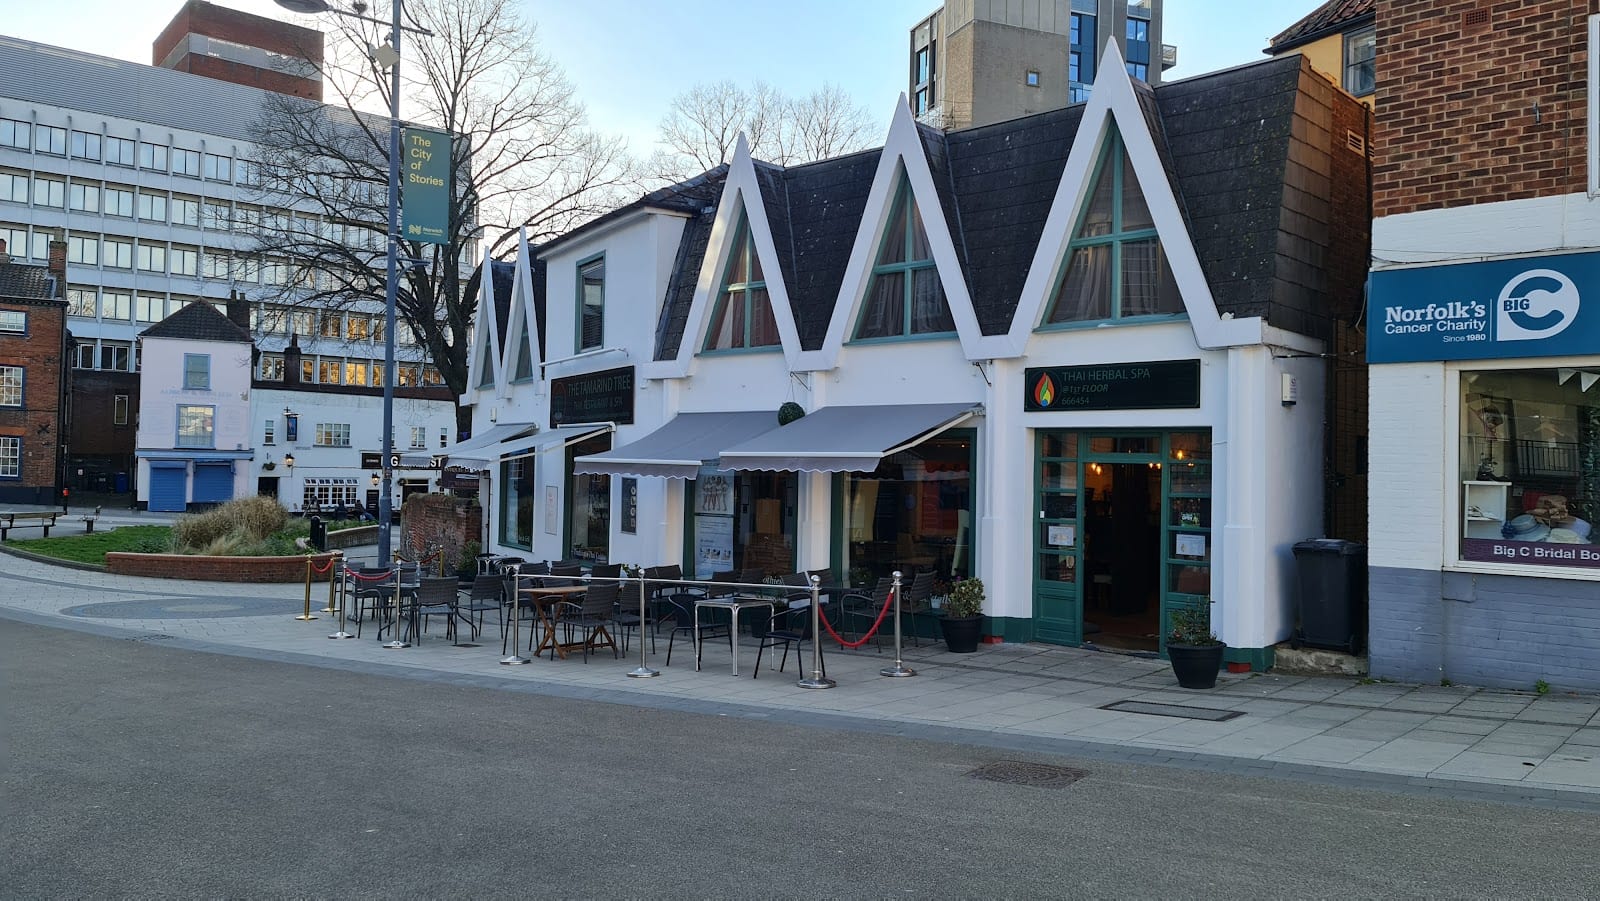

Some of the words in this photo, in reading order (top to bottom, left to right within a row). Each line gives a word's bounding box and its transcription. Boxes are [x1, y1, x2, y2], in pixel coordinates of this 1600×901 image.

[411, 135, 431, 147] The
[410, 148, 432, 161] City
[410, 161, 422, 171] of
[409, 173, 444, 186] Stories
[1384, 300, 1486, 323] Norfolk's
[1503, 298, 1530, 312] BIG
[1384, 322, 1433, 335] Cancer
[1436, 319, 1486, 333] Charity
[1442, 335, 1465, 343] Since
[1466, 334, 1486, 342] 1980
[1061, 371, 1086, 382] THAI
[1088, 369, 1128, 381] HERBAL
[1130, 367, 1151, 380] SPA
[567, 382, 579, 397] THE
[580, 376, 613, 395] TAMARIND
[613, 374, 631, 392] TREE
[1081, 384, 1109, 393] FLOOR
[1061, 396, 1090, 405] 666454
[1493, 545, 1516, 558] Big
[1519, 546, 1530, 557] C
[1534, 547, 1576, 559] Bridal
